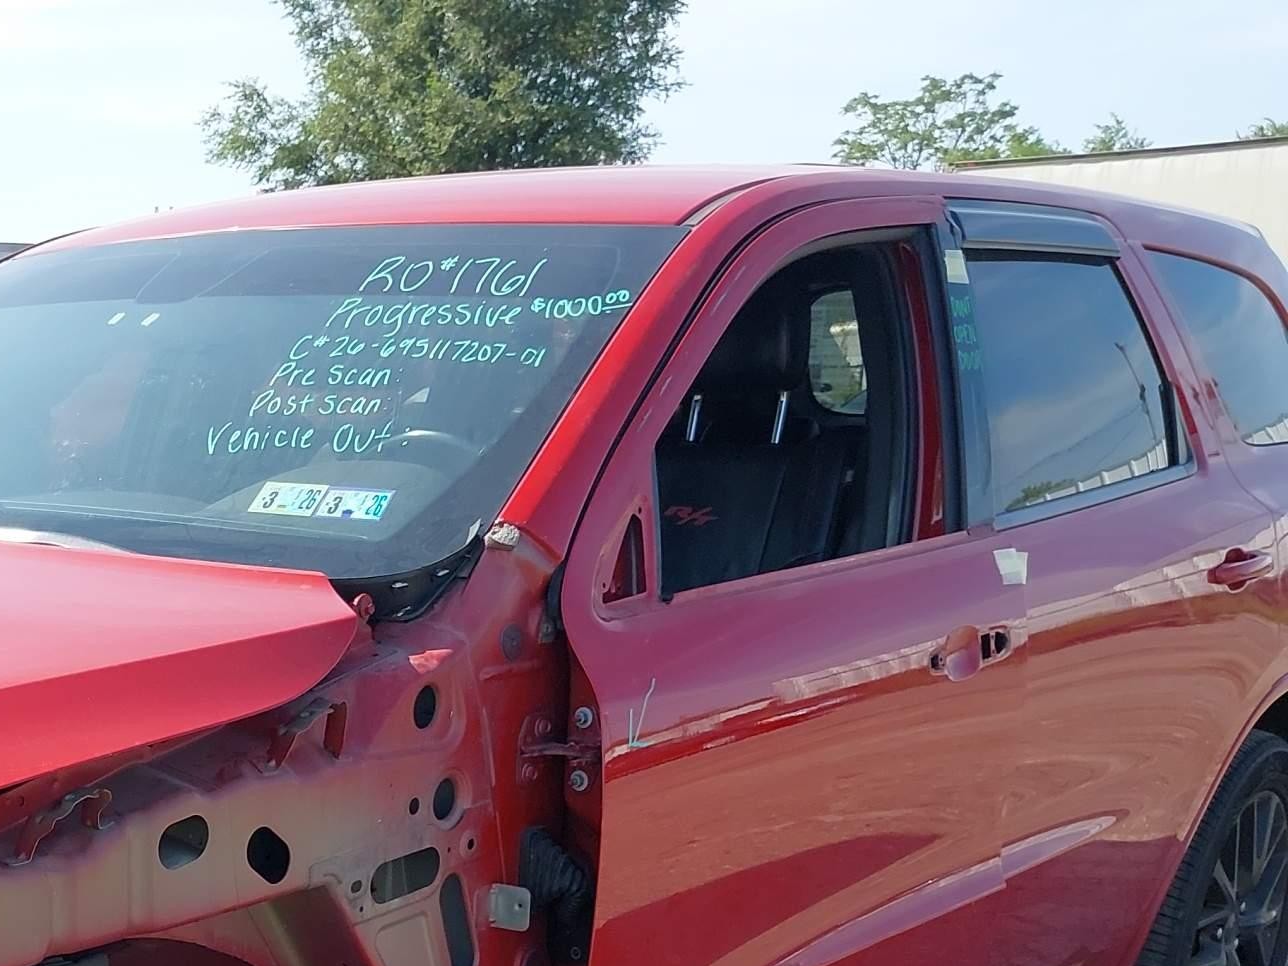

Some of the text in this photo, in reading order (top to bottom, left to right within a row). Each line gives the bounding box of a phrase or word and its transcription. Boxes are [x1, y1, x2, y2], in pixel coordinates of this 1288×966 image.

[324, 298, 522, 337] Progressive
[268, 361, 315, 386] Pre
[248, 389, 314, 417] Post
[207, 422, 314, 455] Vehicle
